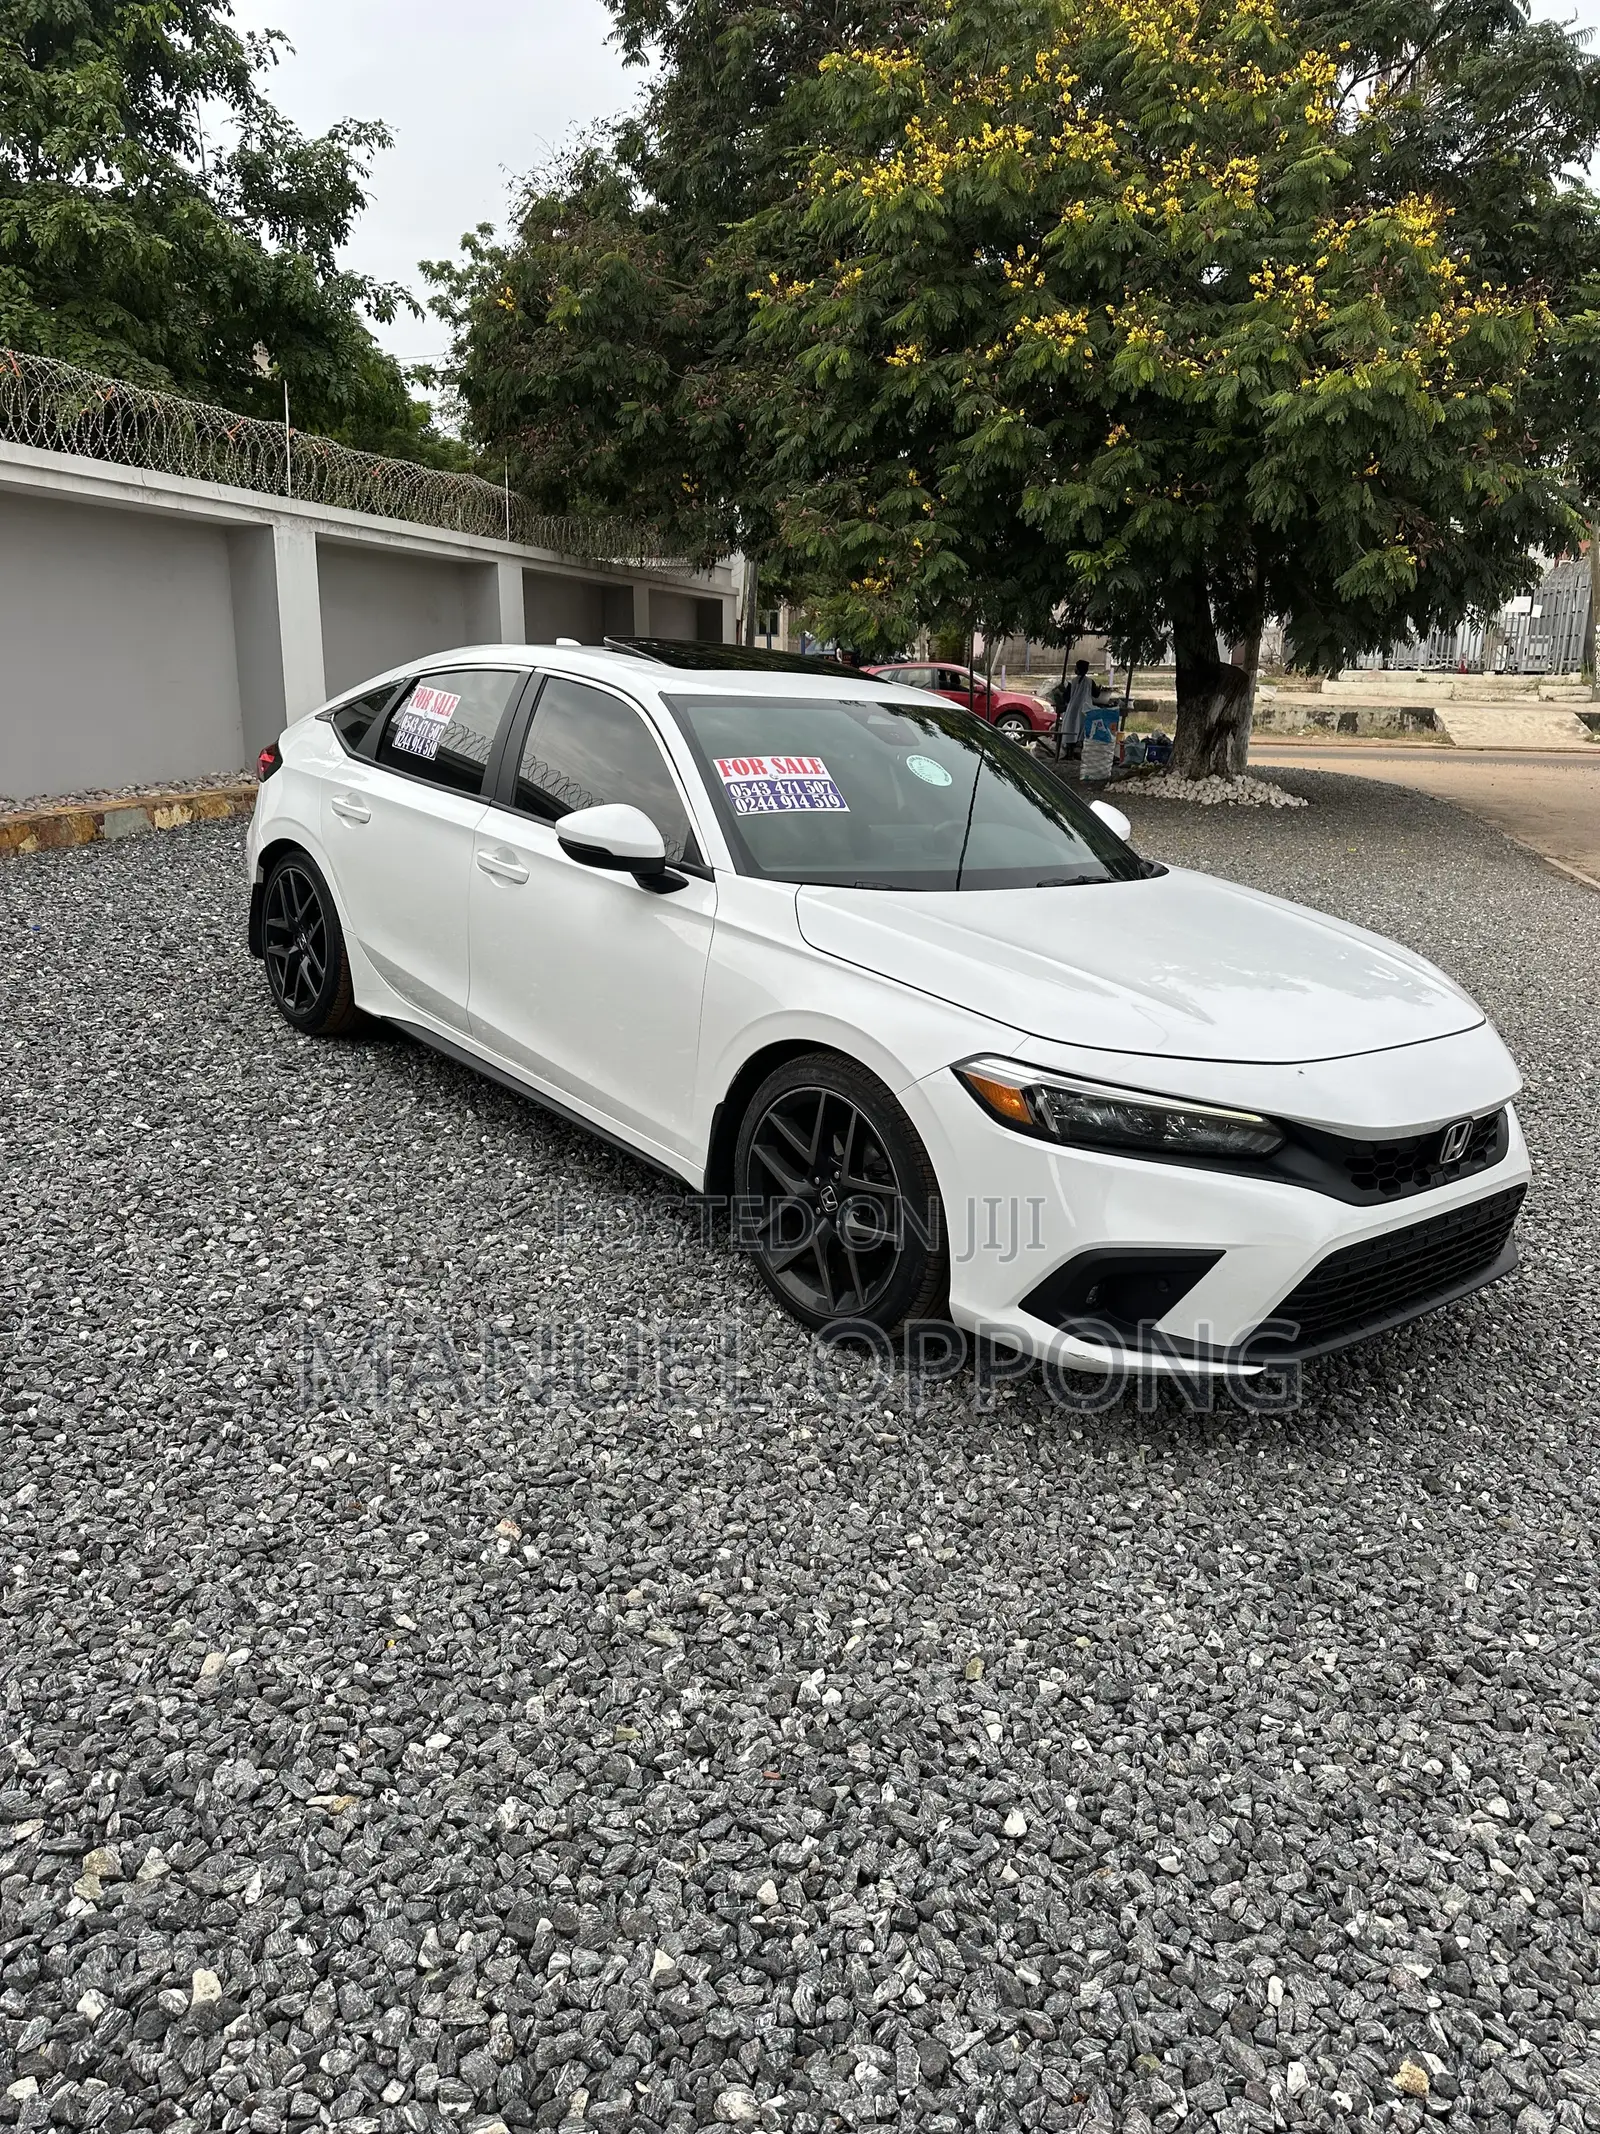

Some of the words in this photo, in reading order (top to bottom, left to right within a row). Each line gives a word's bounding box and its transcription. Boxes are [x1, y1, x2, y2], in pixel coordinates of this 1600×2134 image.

[410, 687, 435, 710] FOR
[430, 692, 459, 717] SALE
[401, 714, 420, 732] 0543
[417, 719, 431, 737] 471
[429, 721, 446, 742] 507
[394, 730, 412, 749] 0244
[410, 735, 424, 753] 914
[422, 739, 438, 758] 519
[717, 758, 768, 777] FOR
[771, 757, 825, 775] SALE
[730, 782, 771, 798] 0543
[775, 781, 801, 795] 471
[804, 780, 833, 795] 507
[735, 797, 779, 813] 0244
[781, 795, 811, 809] 914
[812, 794, 841, 808] 519
